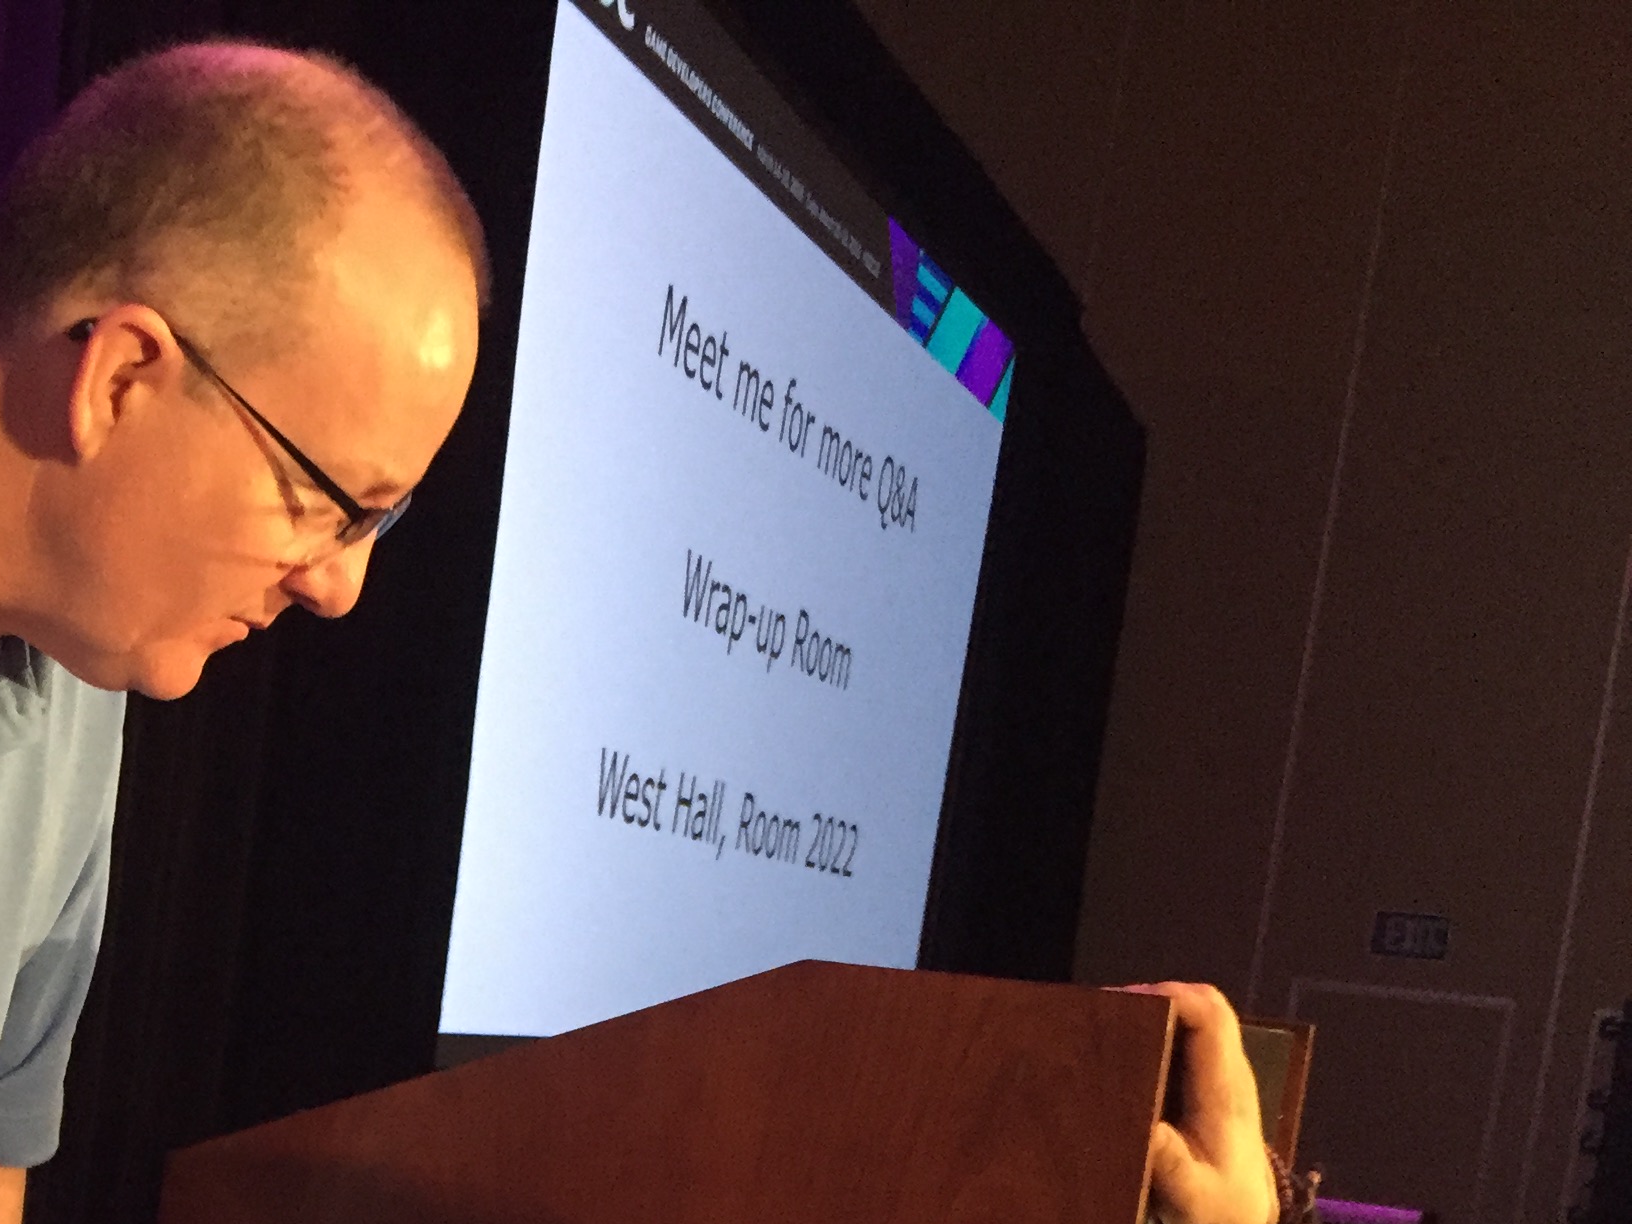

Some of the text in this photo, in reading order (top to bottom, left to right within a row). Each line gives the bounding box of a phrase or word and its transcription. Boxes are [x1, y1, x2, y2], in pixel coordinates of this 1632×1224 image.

[658, 284, 918, 533] Meet me for more Q&A
[683, 548, 852, 690] Wrap-up Room
[597, 747, 858, 877] West Hall, Room 2022
